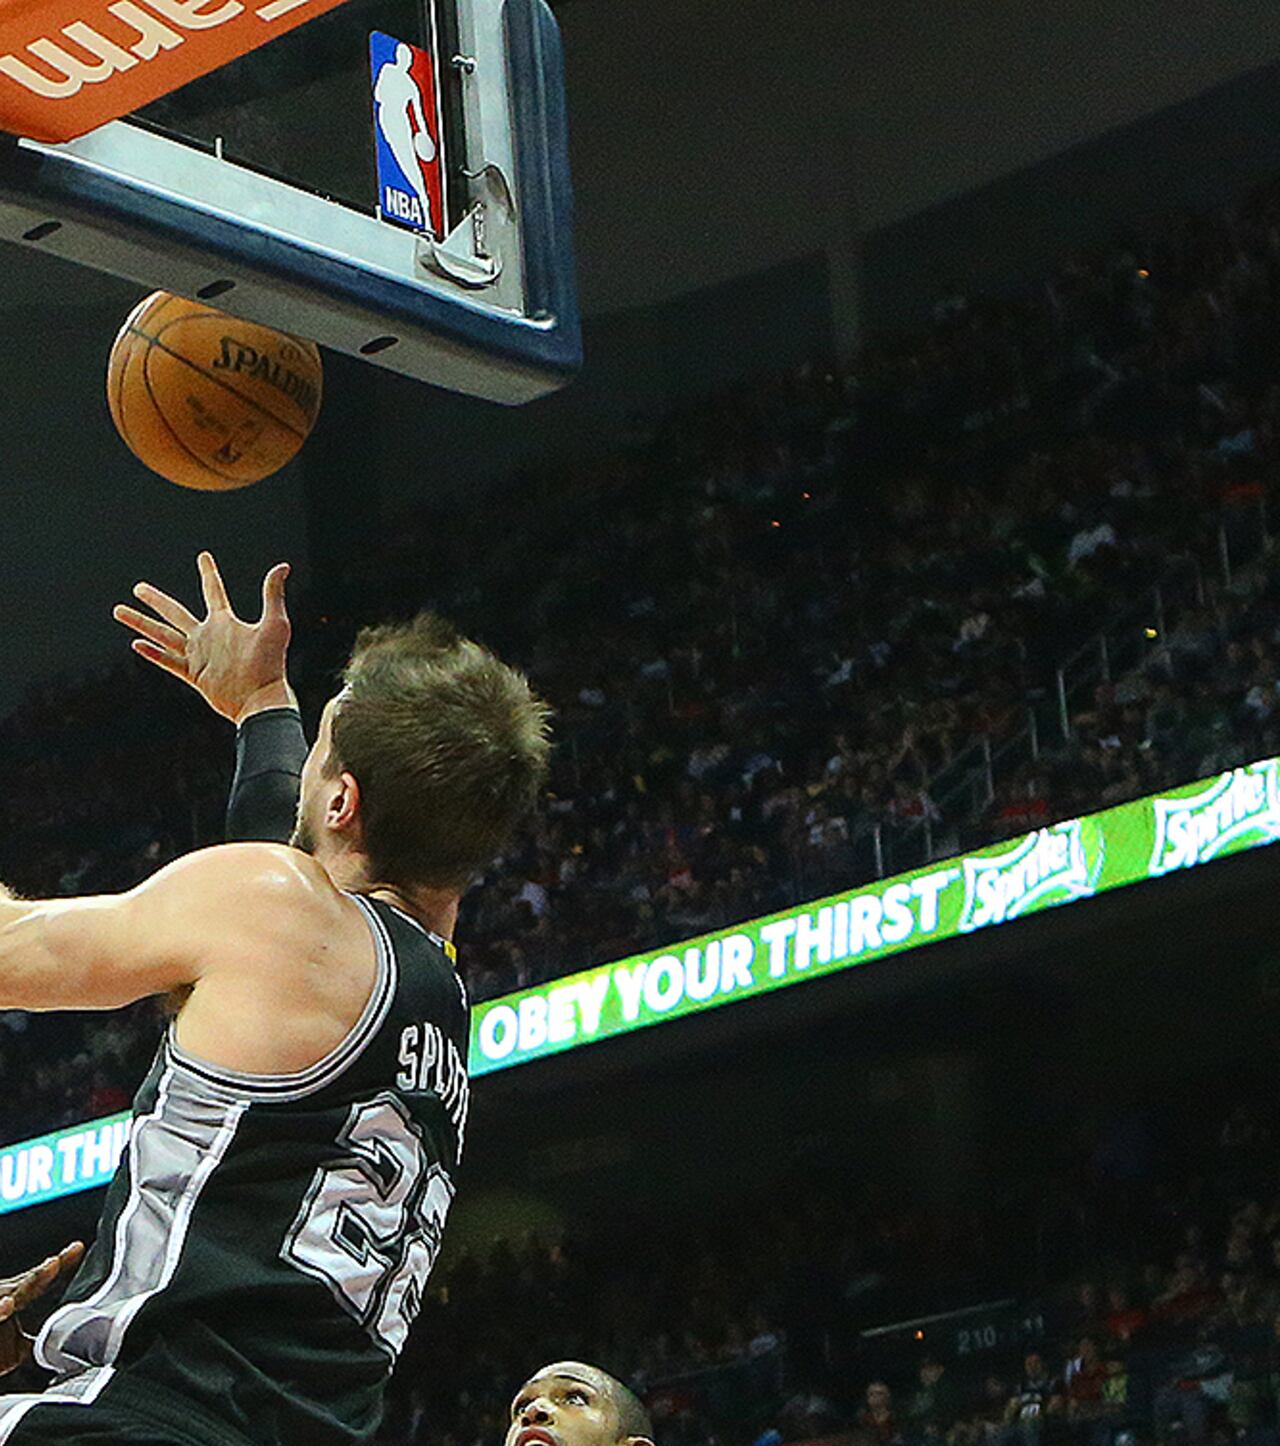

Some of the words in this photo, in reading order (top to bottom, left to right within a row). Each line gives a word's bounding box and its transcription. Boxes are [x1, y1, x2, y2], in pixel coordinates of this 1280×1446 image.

[386, 185, 422, 224] NBA
[213, 336, 320, 412] SPALDIN
[1162, 767, 1265, 868] Sprite
[973, 827, 1069, 925] Sprite
[479, 973, 609, 1061] OBEY
[611, 932, 755, 1022] YOUR
[760, 875, 949, 980] THIRST
[56, 1118, 131, 1183] THI
[279, 1090, 457, 1376] 22
